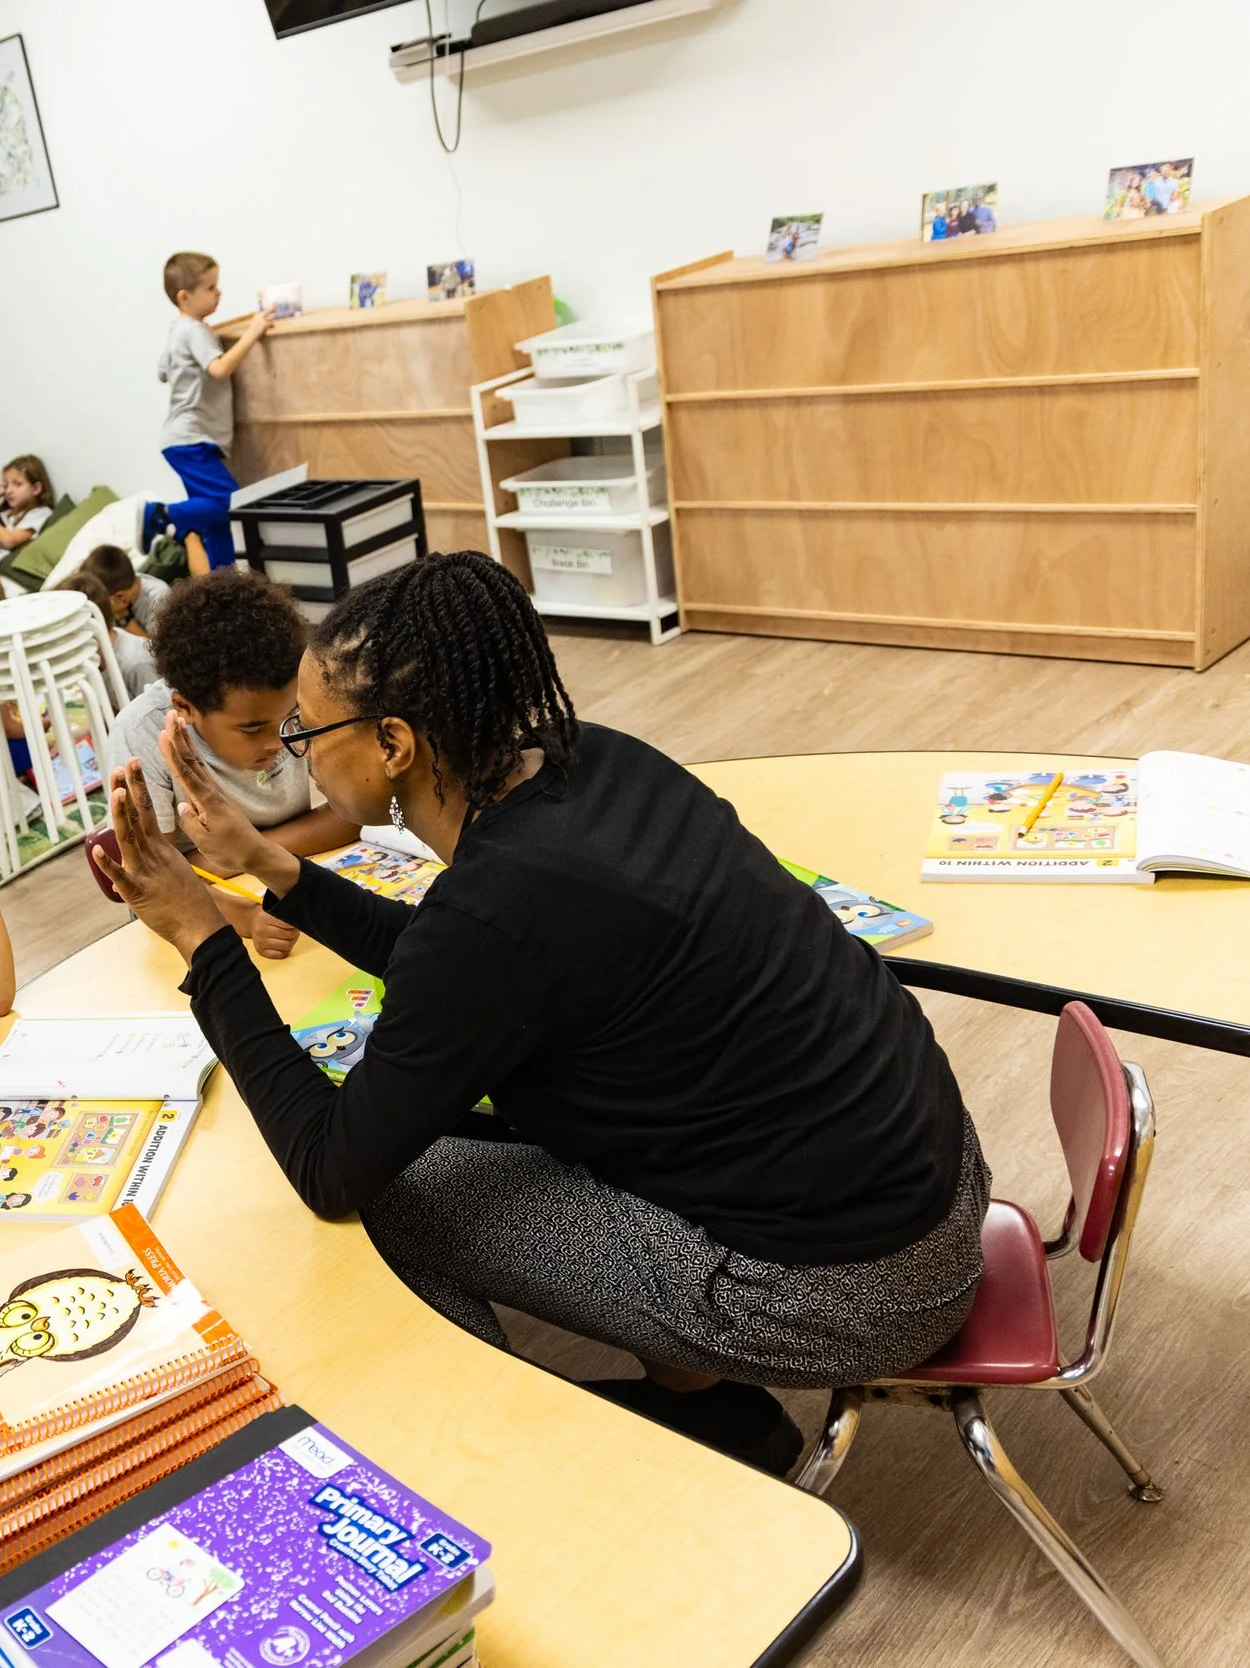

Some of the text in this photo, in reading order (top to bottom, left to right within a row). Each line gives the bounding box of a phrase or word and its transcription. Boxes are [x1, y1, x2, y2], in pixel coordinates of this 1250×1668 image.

[533, 498, 597, 509] Challenge Bin
[141, 1124, 168, 1164] ADDITION
[125, 1165, 150, 1197] WITHIN
[142, 1247, 162, 1269] PRESS
[314, 1487, 408, 1546] Primary
[322, 1517, 423, 1585] Journal
[329, 1538, 360, 1561] Creative
[357, 1555, 379, 1574] Story
[427, 1542, 456, 1565] K-2
[12, 1618, 36, 1643] K-2
